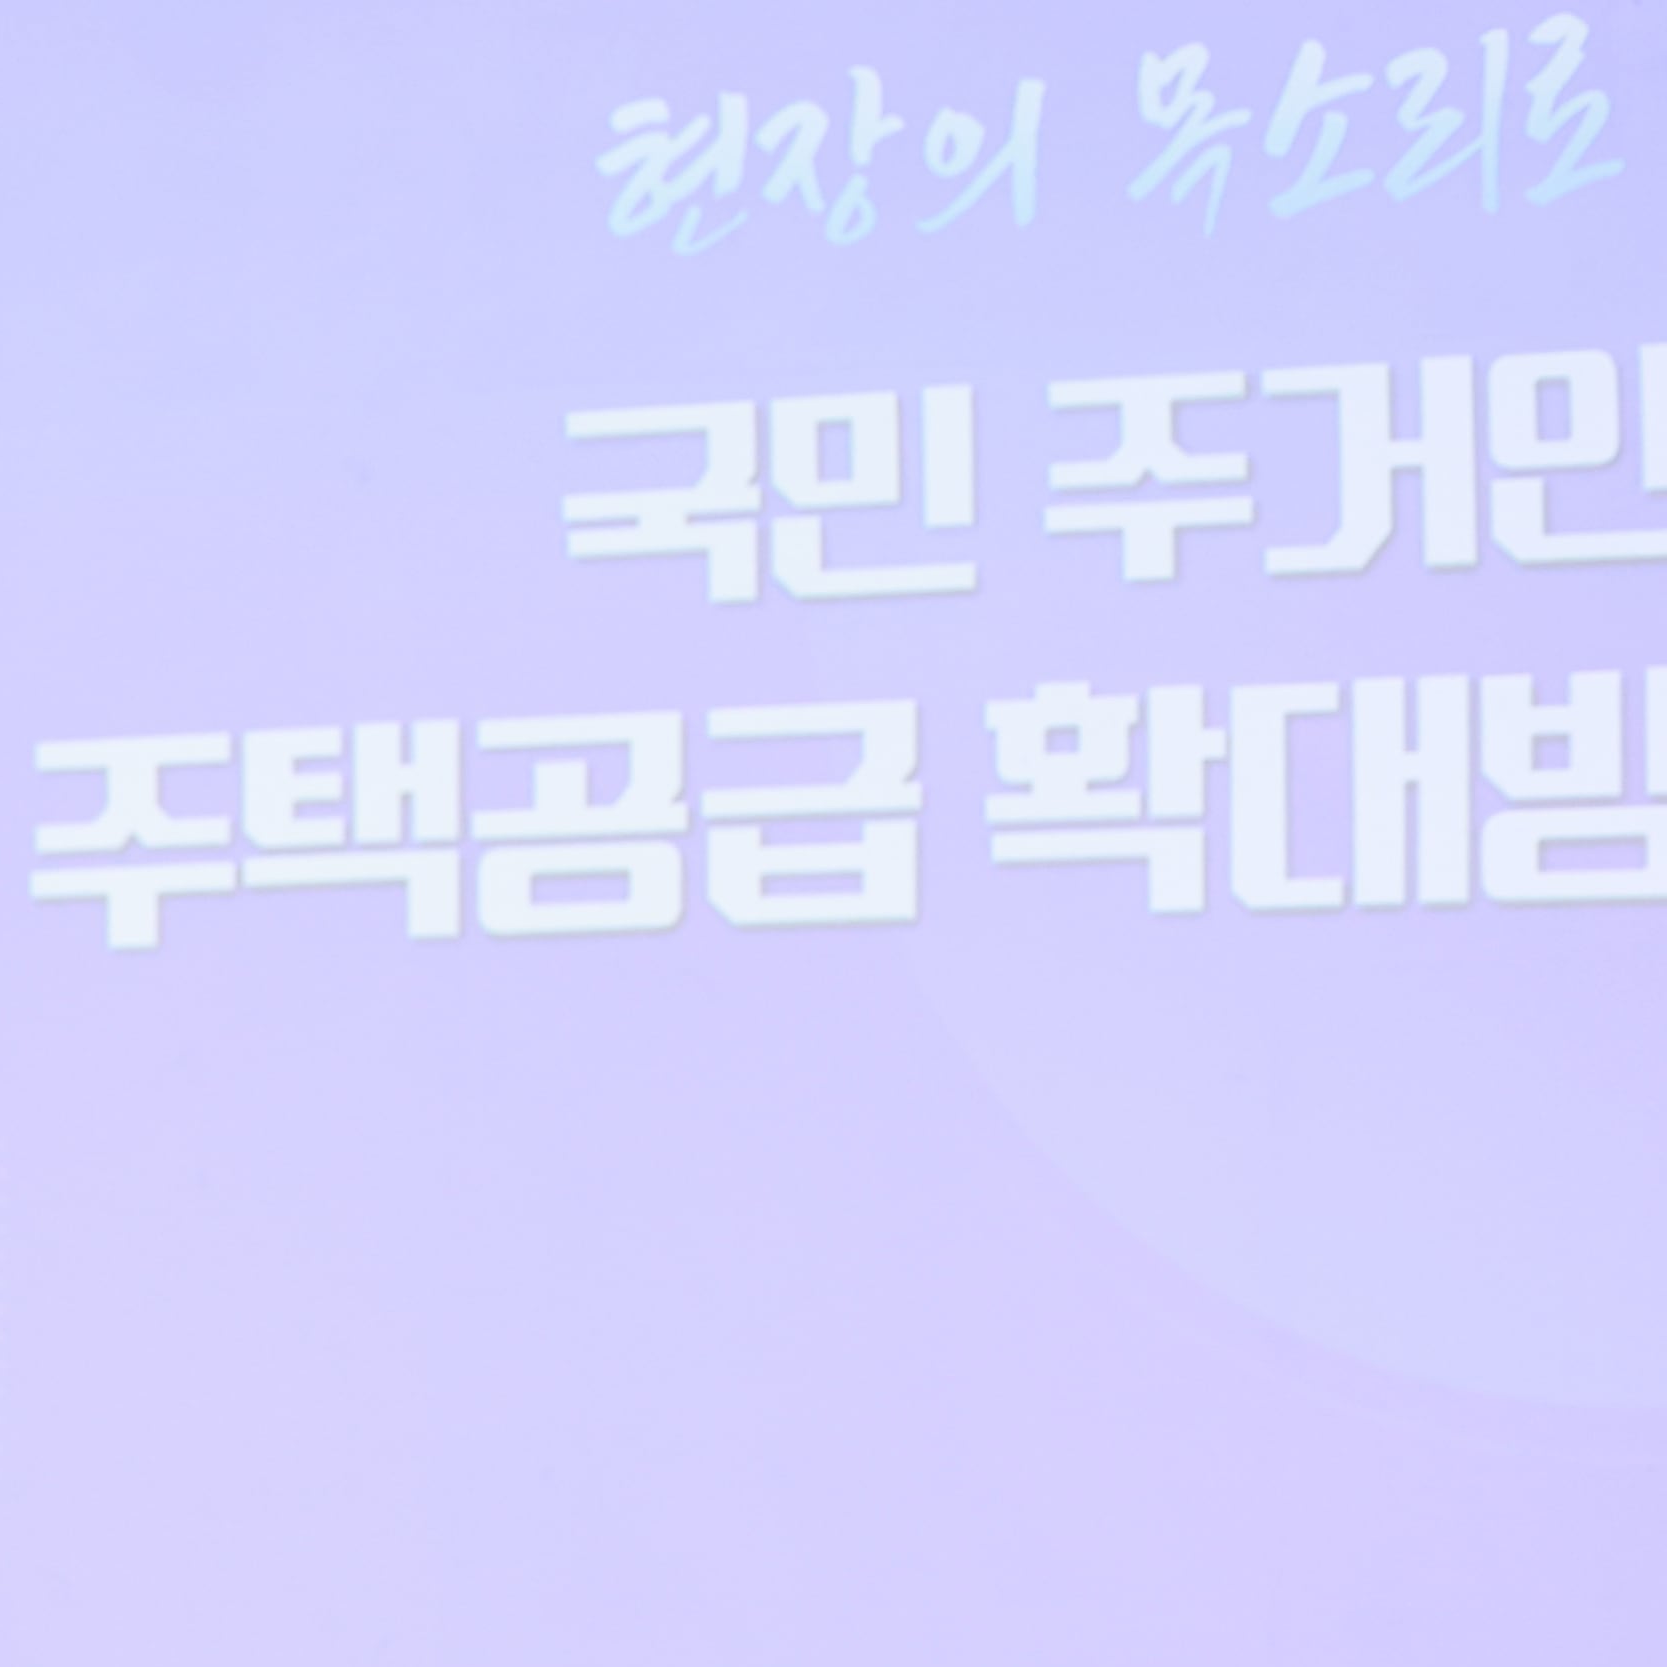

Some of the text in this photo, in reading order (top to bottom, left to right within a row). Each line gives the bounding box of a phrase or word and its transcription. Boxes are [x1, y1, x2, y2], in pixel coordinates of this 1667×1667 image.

[595, 11, 1627, 255] 현장의 목소리로
[560, 382, 978, 604] 국민
[29, 697, 924, 950] 주택공급
